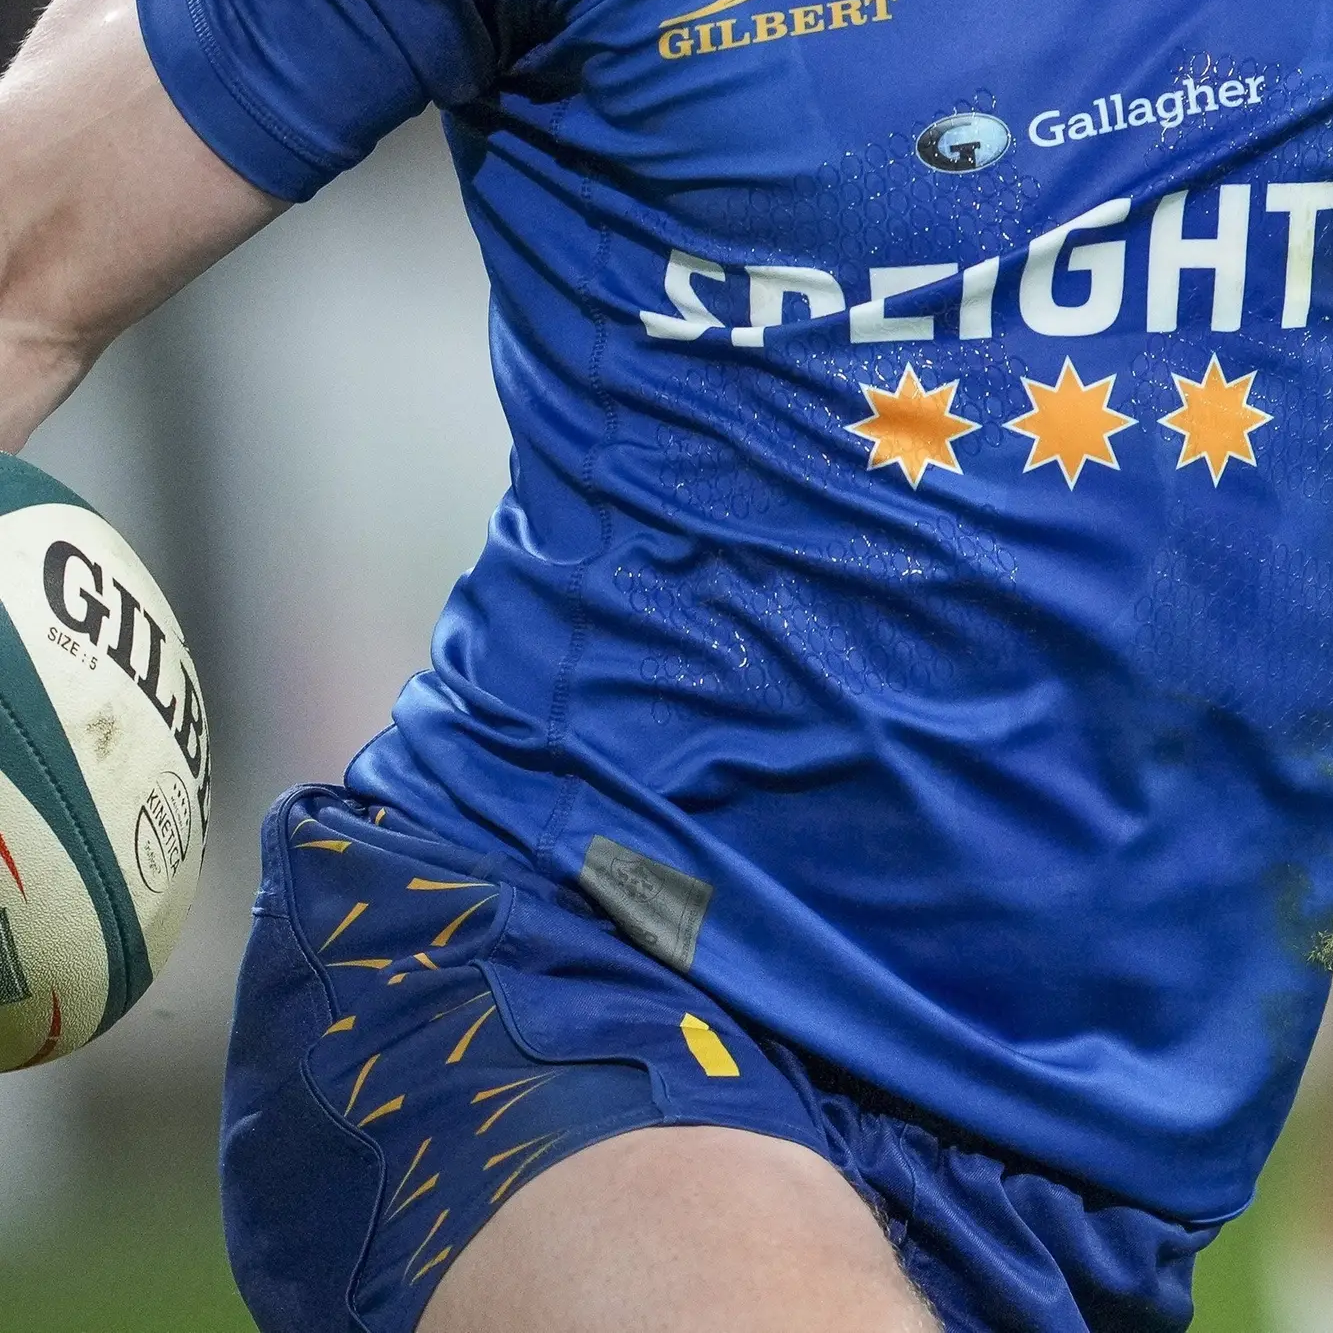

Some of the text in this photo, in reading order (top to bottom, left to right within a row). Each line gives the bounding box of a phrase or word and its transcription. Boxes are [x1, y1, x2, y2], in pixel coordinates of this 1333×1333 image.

[1028, 73, 1266, 148] Gallagher
[47, 626, 81, 657] SIZE
[89, 656, 99, 671] 5
[146, 787, 180, 879] KINETICA
